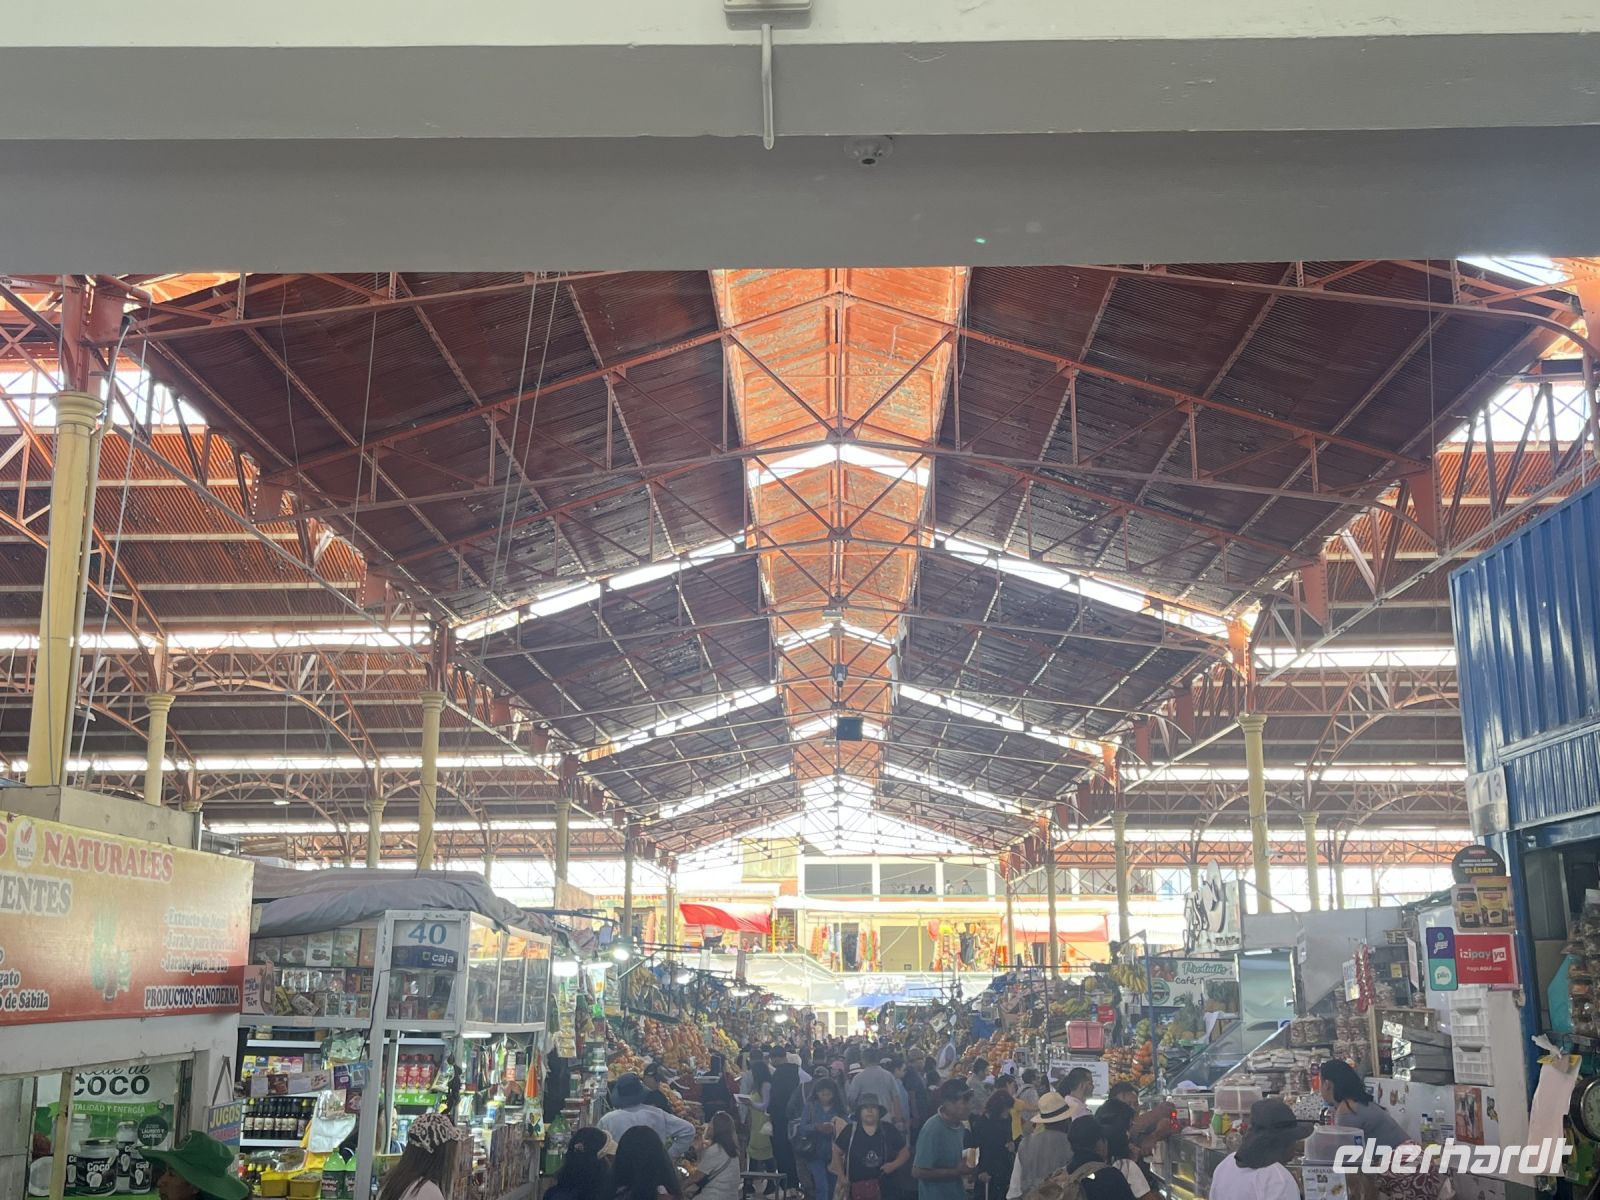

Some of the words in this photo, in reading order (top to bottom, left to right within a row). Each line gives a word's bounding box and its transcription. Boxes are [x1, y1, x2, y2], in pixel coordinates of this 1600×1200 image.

[43, 831, 173, 881] NATURALES
[0, 874, 72, 913] ENTES
[408, 923, 447, 945] 40
[431, 953, 454, 965] caja
[1459, 948, 1490, 960] izipay
[1494, 950, 1505, 959] ya
[4, 992, 17, 1010] de
[18, 990, 49, 1009] Sábila
[145, 987, 194, 1007] PRODUCTOS
[195, 986, 239, 1005] GANODERMA
[73, 1075, 150, 1096] COCO
[210, 1104, 240, 1129] JUGOS
[87, 1162, 110, 1172] Coco
